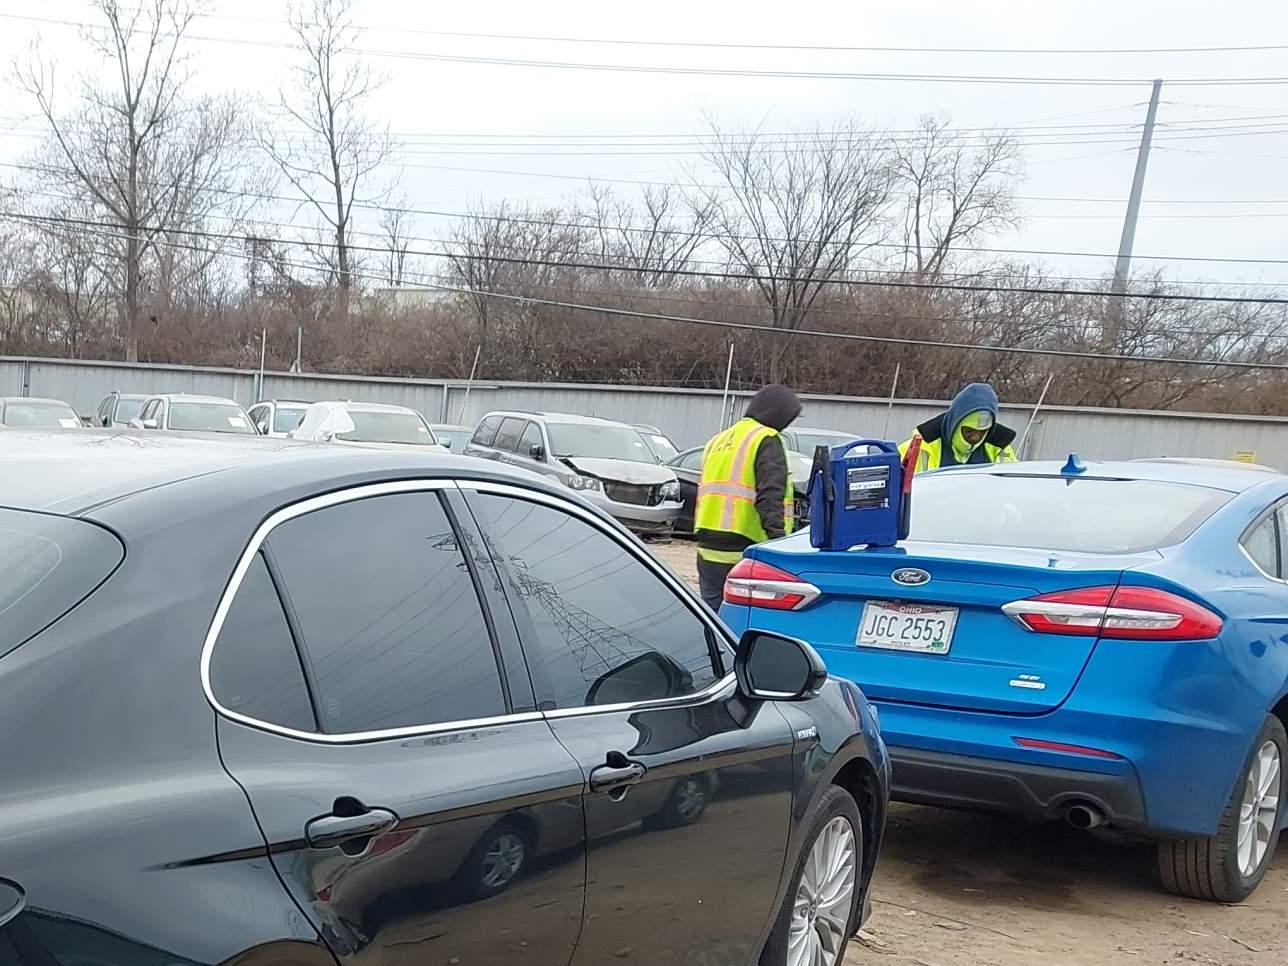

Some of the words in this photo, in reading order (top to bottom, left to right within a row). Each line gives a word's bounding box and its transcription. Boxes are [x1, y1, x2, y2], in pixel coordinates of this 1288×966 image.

[899, 606, 922, 614] OHIO
[865, 614, 898, 638] JGC
[901, 617, 946, 642] 2553
